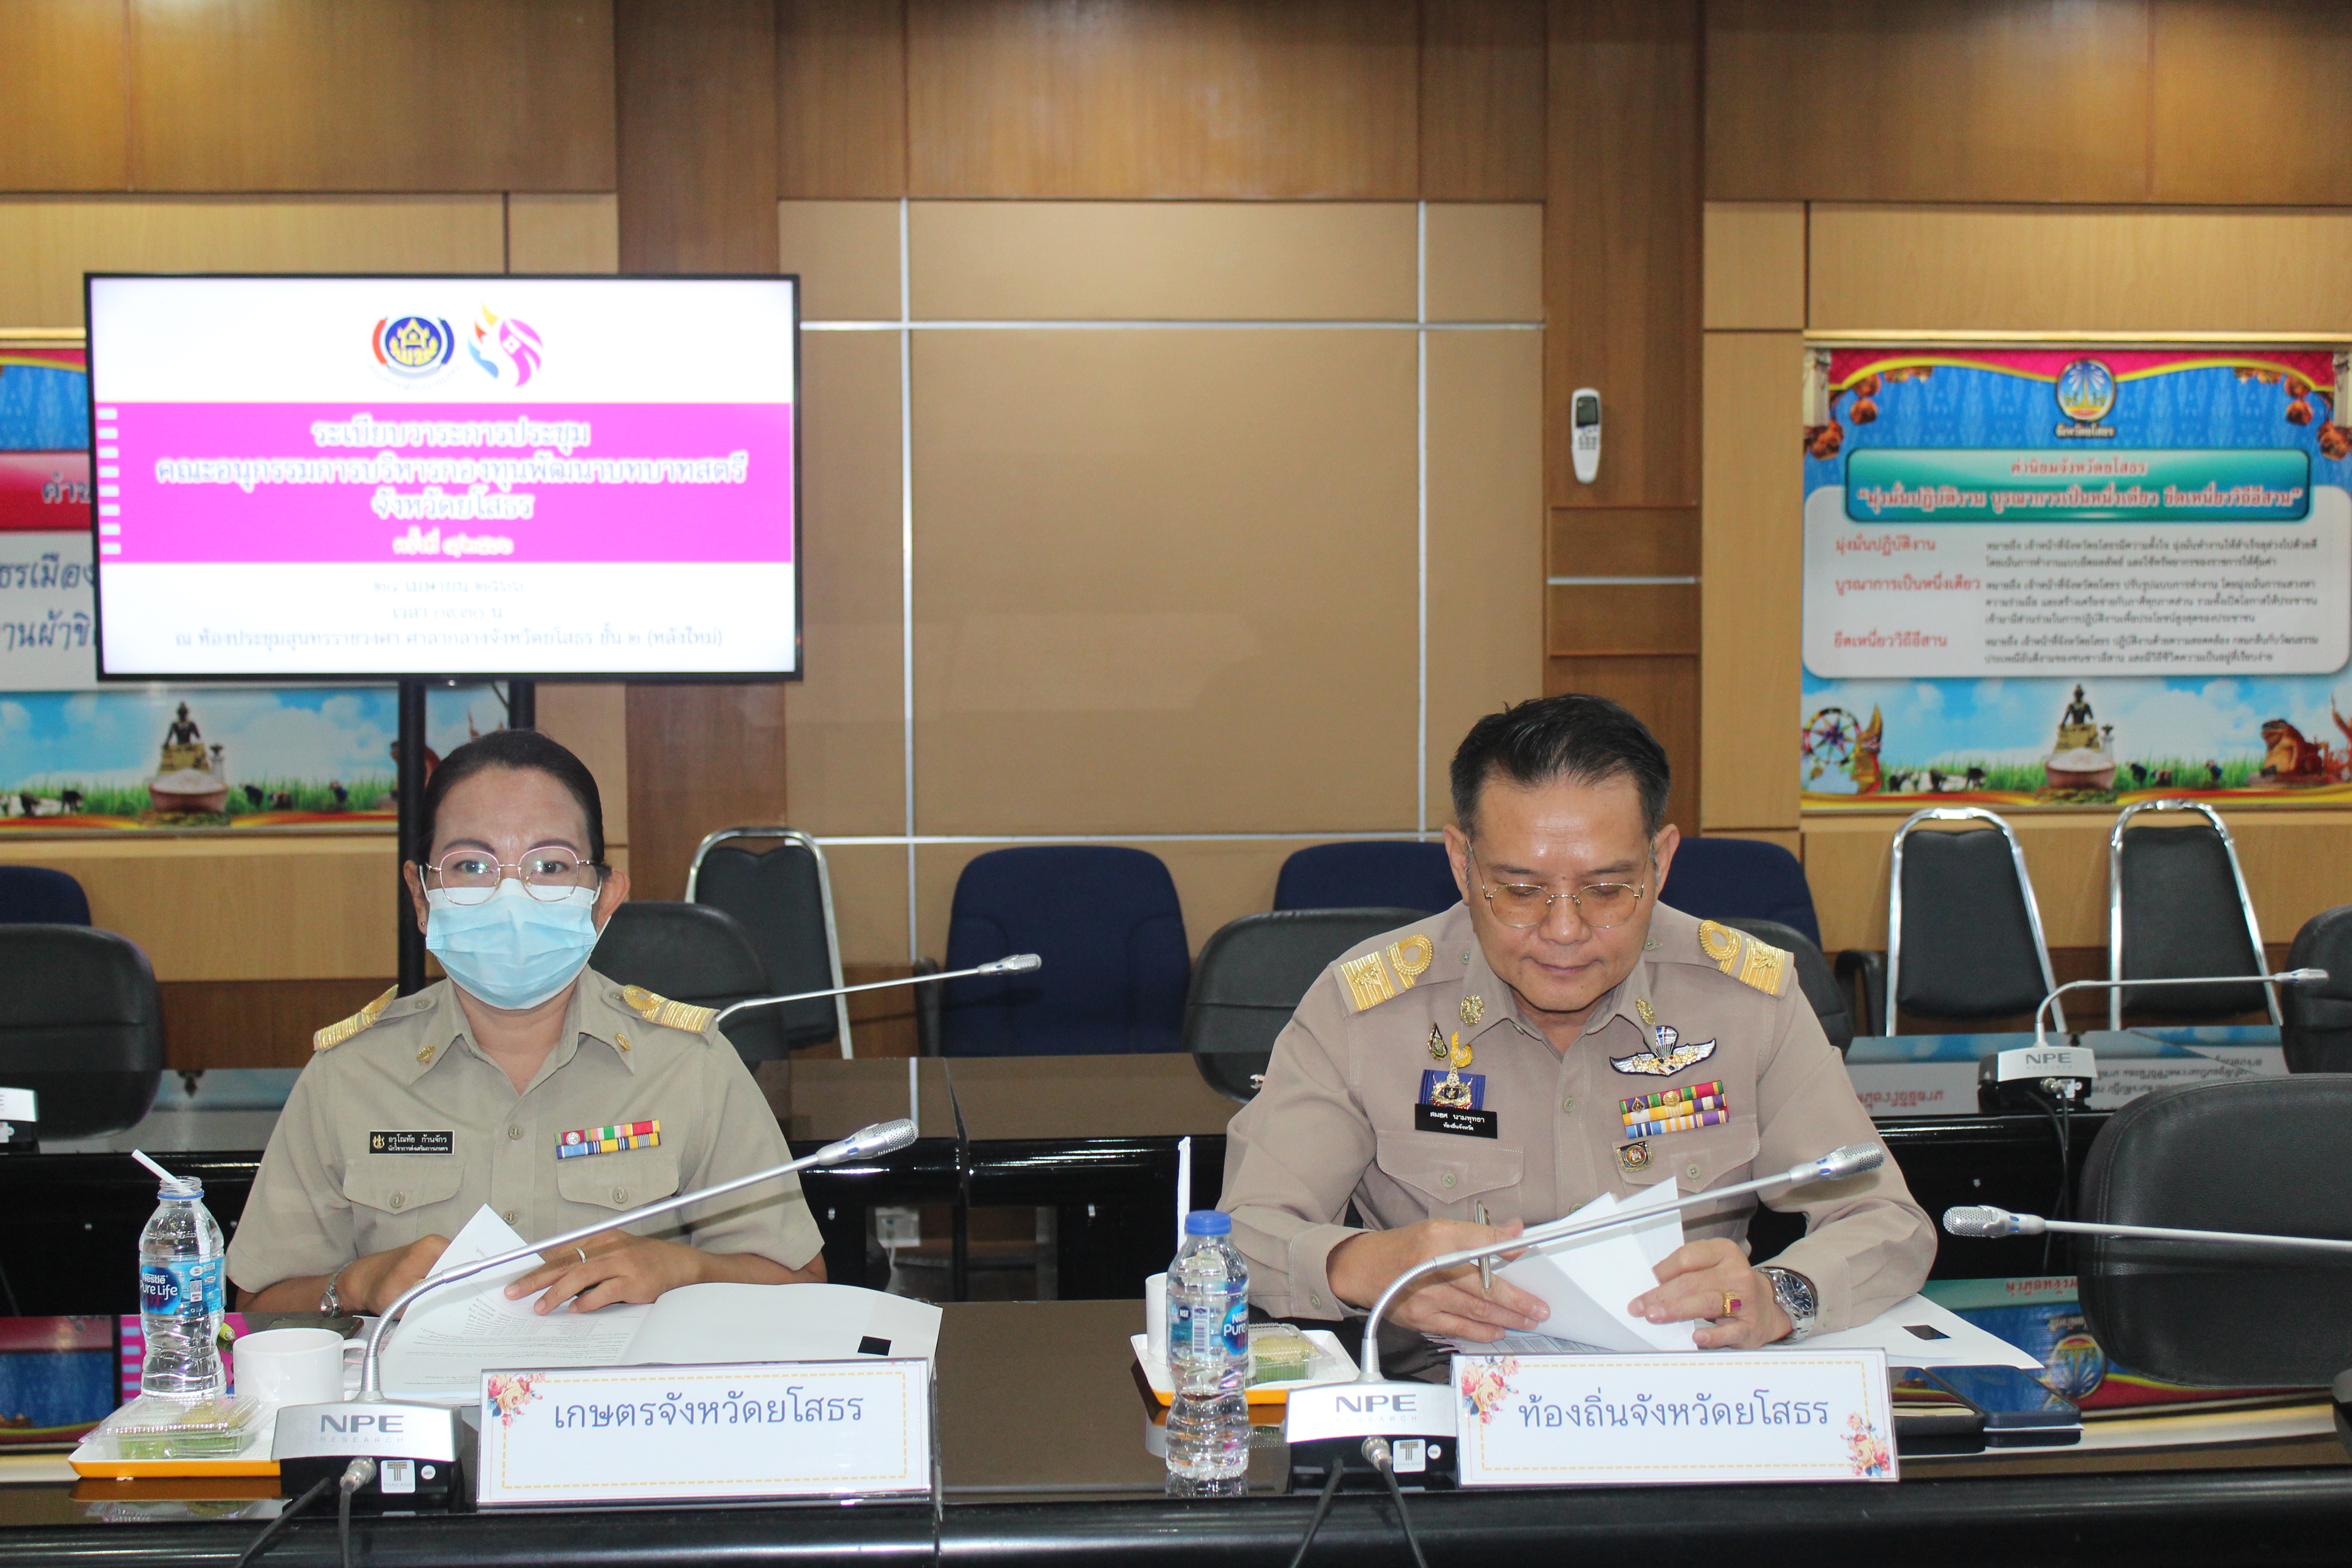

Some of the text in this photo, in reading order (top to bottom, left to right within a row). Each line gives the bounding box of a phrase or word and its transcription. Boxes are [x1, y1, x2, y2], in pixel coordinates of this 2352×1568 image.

[313, 415, 588, 455] ระเบียบวาระการประชุม
[157, 451, 747, 492] คณะอนุกรรมการบริหารกองทุนพัฒนาบทบาทสตรี
[2011, 455, 2148, 475] ค่านิยมจังหวัดยโสธร
[372, 485, 534, 519] จังหวัดยโสธร
[1836, 532, 1936, 556] มุ่งมั่นปฏิบัติงาน
[405, 580, 469, 593] เมษายน
[1835, 570, 1980, 597] บูรณาการเป็นหนึ่งเดียว
[392, 606, 427, 620] เวลา
[407, 626, 593, 646] ศาลากลางจังหวัดยโสธร
[1834, 627, 1947, 648] ยึดเหนี่ยววิถีอีสาน
[2026, 1053, 2072, 1064] NPE
[140, 1279, 178, 1300] Pure Life
[1179, 1309, 1189, 1318] NSF
[1224, 1322, 1246, 1337] Pure
[555, 1386, 864, 1428] เกษตรจังหวัดยโสธร
[1336, 1394, 1417, 1413] NPE
[1518, 1387, 1828, 1427] ท้องถิ่นจังหวัดยโสธร
[320, 1414, 404, 1433] NPE
